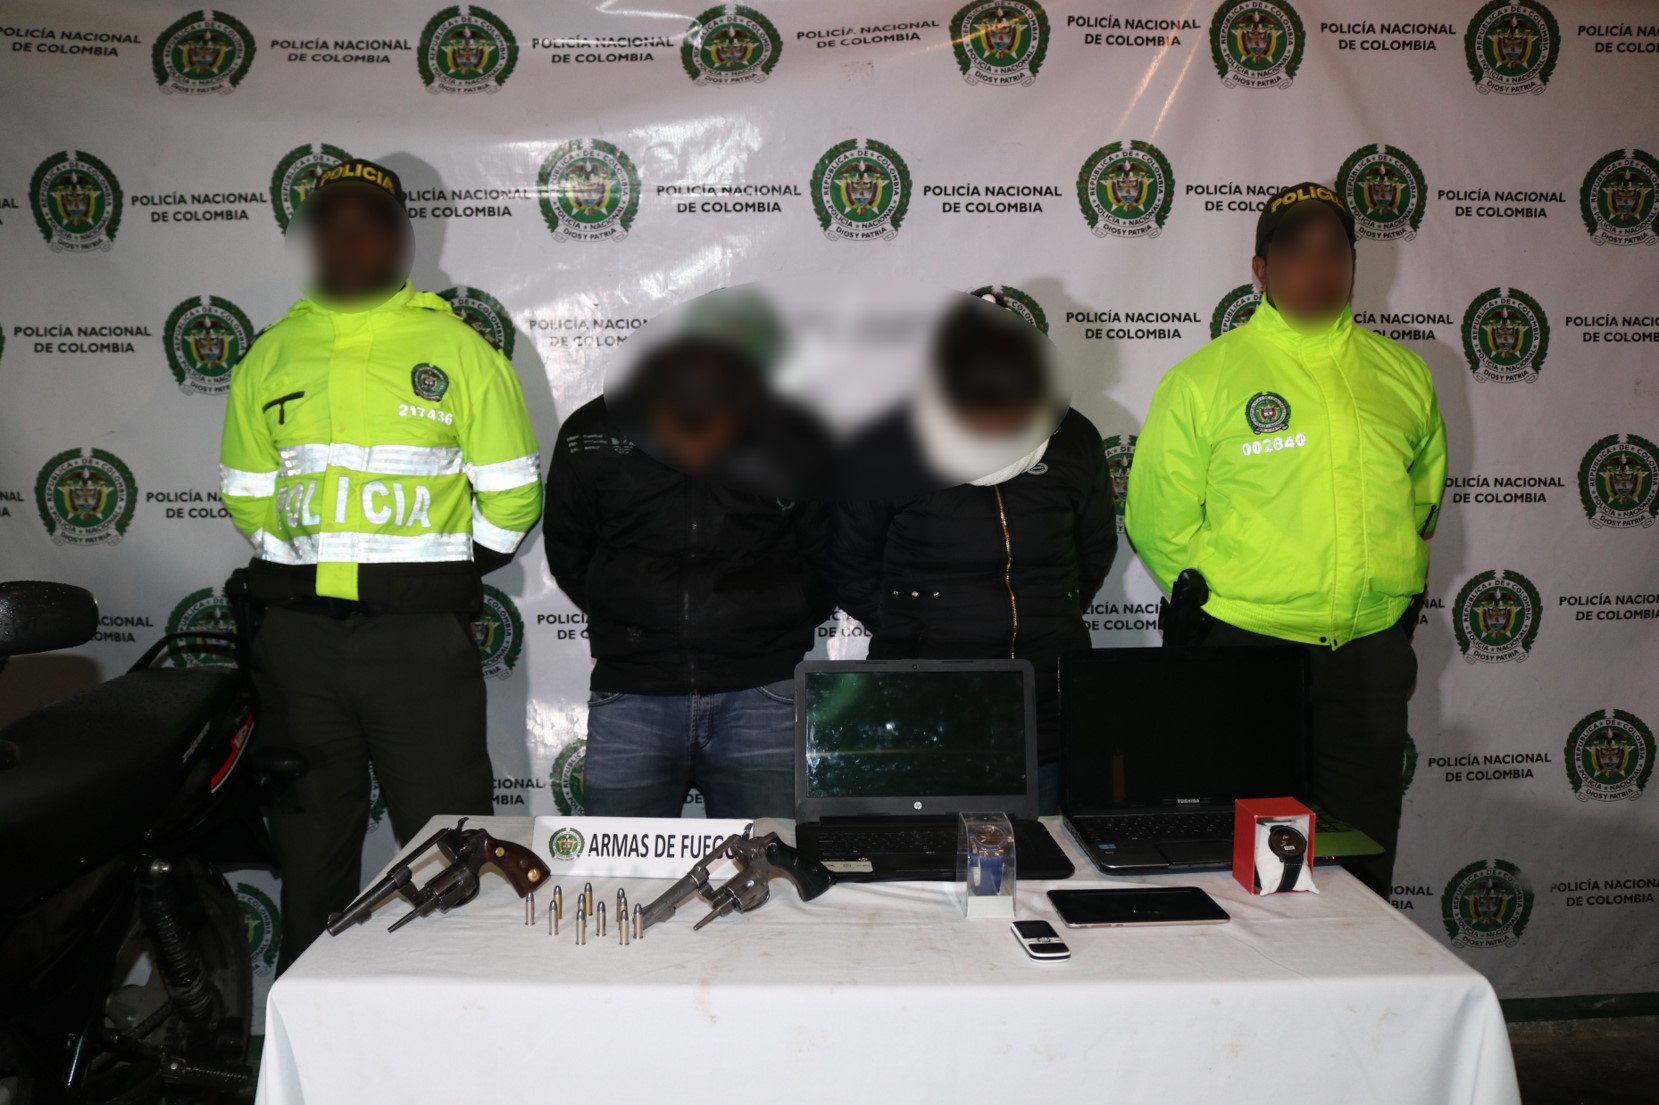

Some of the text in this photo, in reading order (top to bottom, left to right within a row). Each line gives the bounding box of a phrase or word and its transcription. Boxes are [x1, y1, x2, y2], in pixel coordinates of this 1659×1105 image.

[1068, 15, 1200, 30] POLICÍA NACIONAL
[1321, 21, 1456, 34] POLICÍA NACIONAL
[0, 26, 141, 43] OLICÍA NACIONAL
[797, 20, 940, 40] POLICÍA NACIONAL
[1578, 23, 1632, 36] POLICÍA
[271, 38, 411, 50] POLICÍA NACIONAL
[532, 35, 674, 48] POLICÍA NACIONAL
[817, 33, 920, 48] DE COLOMBIA
[1085, 34, 1181, 46] DE COLOMBIA
[1339, 40, 1436, 50] DE COLOMBIA
[12, 42, 118, 56] DE COLOMBIA
[1595, 42, 1659, 53] DE COLO
[288, 53, 390, 63] DE COLOMBIA
[552, 53, 653, 63] DE COLOMBIA
[319, 162, 396, 194] POLICIA
[877, 156, 899, 196] COLOMBIA
[1142, 154, 1163, 194] COLOMBIA
[402, 187, 531, 201] LICÍA NACIONAL
[657, 184, 801, 195] POLICÍA NACIONAL
[923, 182, 1062, 197] POLICÍA NACIONAL
[1186, 182, 1288, 195] POLICÍA NACI
[131, 192, 267, 206] POLICÍA NACIONAL
[1438, 188, 1566, 202] POLICÍA NACIONAL
[409, 206, 511, 218] DE COLOMBIA
[678, 202, 781, 212] DE COLOMBIA
[943, 203, 1042, 213] DE COLOMBIA
[1205, 201, 1265, 211] DE COLO
[151, 210, 248, 222] DE COLOMBIA
[862, 205, 896, 228] NACIONAL
[1129, 203, 1160, 225] NACIONAL
[1456, 207, 1547, 218] DE COLOMBIA
[862, 227, 887, 238] PATRIA
[1129, 225, 1152, 235] PATRIA
[1067, 310, 1201, 323] POLICÍA NACIONAL
[1381, 314, 1453, 324] NACIONAL
[1566, 314, 1659, 327] POLICÍA NACI
[529, 317, 642, 330] POLICÍA NACIO
[14, 325, 151, 337] POLICÍA NACIONAL
[1086, 329, 1181, 339] DE COLOMBIA
[1373, 330, 1436, 340] LOMBIA
[1583, 332, 1659, 342] DE COLOMB
[550, 336, 627, 346] DE COLOM
[34, 343, 134, 353] DE COLOMBIA
[398, 404, 453, 425] 217436
[1242, 433, 1306, 456] 002840
[1444, 474, 1565, 488] OLICÍA NACIONAL
[147, 490, 203, 502] POLICÍA
[1453, 493, 1546, 503] DE COLOMBIA
[276, 476, 432, 531] POLICIA
[166, 508, 230, 518] DE COLO
[1559, 593, 1659, 606] POLICÍA NACIO
[1083, 602, 1159, 614] ICÍA NACI
[99, 616, 153, 627] CIONAL
[537, 613, 587, 624] POLICÍ
[1576, 611, 1592, 620] DE
[1104, 620, 1157, 630] COLOM
[93, 632, 136, 642] OMBIA
[558, 630, 575, 639] DE
[818, 627, 837, 638] DE
[1428, 753, 1551, 767] POLICÍA NACIONAL
[1446, 769, 1534, 782] DE COLOMBIA
[492, 779, 545, 789] IONAL
[492, 795, 524, 805] MBIA
[686, 794, 702, 804] DE
[589, 833, 649, 858] ARMAS
[655, 834, 676, 858] DE
[1390, 886, 1434, 896] IONAL
[1550, 878, 1659, 893] POLICÍA NACION
[1567, 893, 1654, 906] DE COLOMBIA
